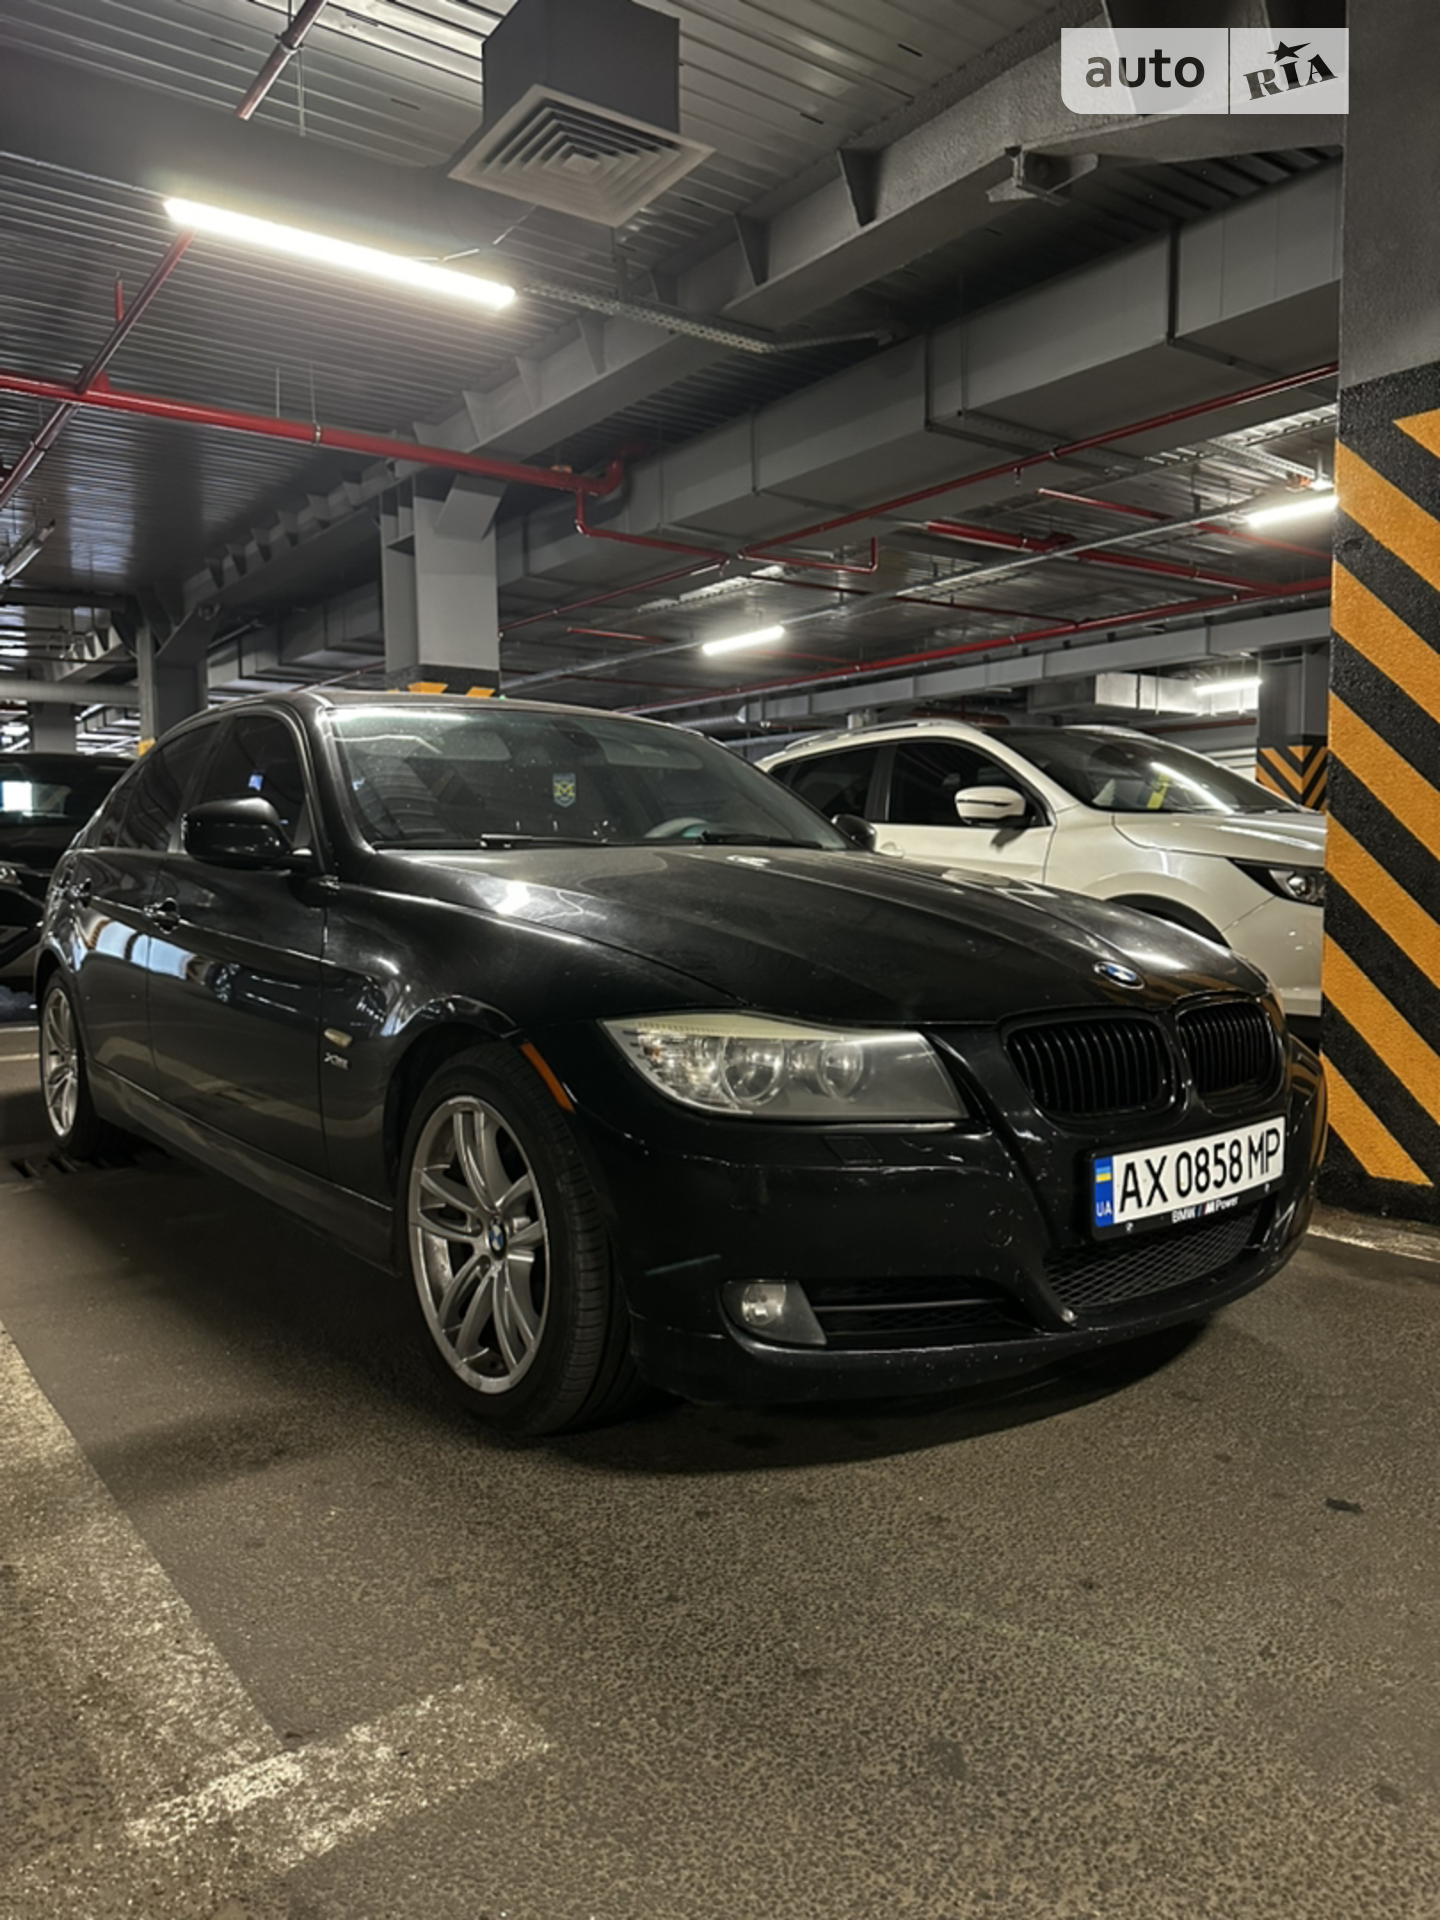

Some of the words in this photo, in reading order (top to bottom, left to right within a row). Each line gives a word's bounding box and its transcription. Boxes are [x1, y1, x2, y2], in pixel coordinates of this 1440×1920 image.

[1119, 1155, 1169, 1212] AX
[1175, 1138, 1243, 1198] 0858
[1247, 1127, 1281, 1180] MP
[1096, 1200, 1113, 1217] UA
[1172, 1206, 1196, 1224] BMW
